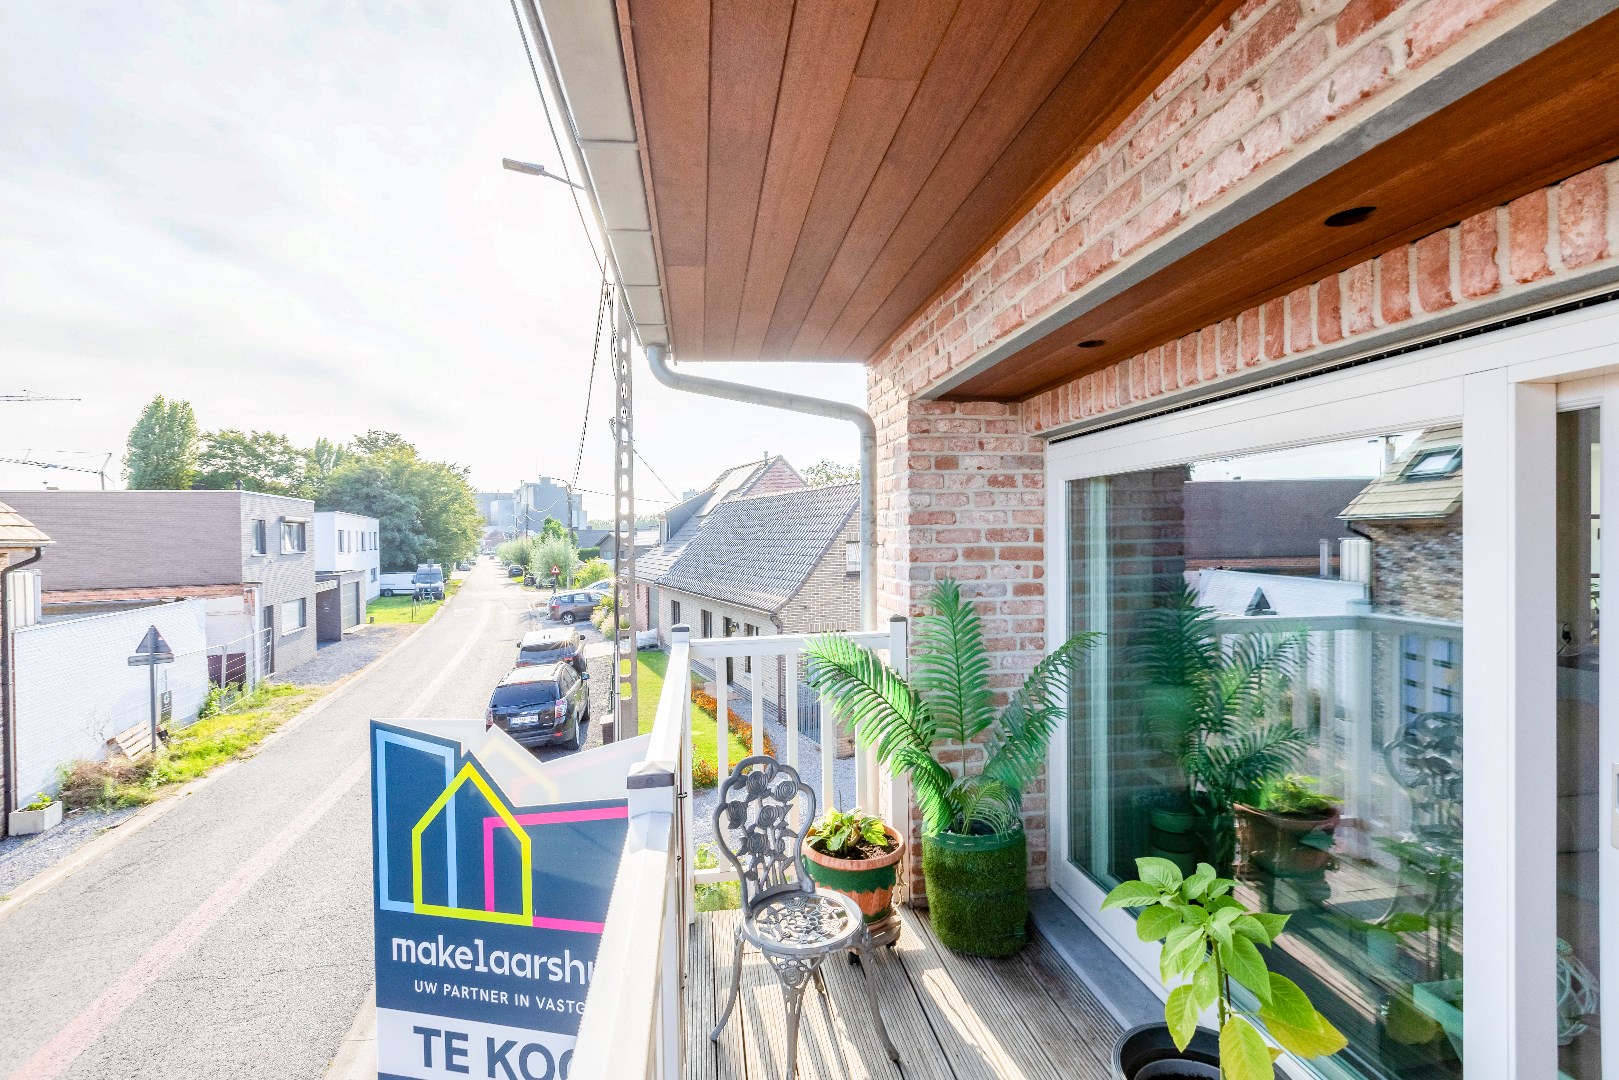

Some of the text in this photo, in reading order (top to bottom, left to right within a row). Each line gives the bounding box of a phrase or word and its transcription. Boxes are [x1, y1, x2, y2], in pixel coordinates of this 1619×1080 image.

[414, 980, 437, 994] UW
[443, 984, 508, 1004] PARTNER
[514, 994, 529, 1007] IN
[413, 1026, 469, 1074] TE
